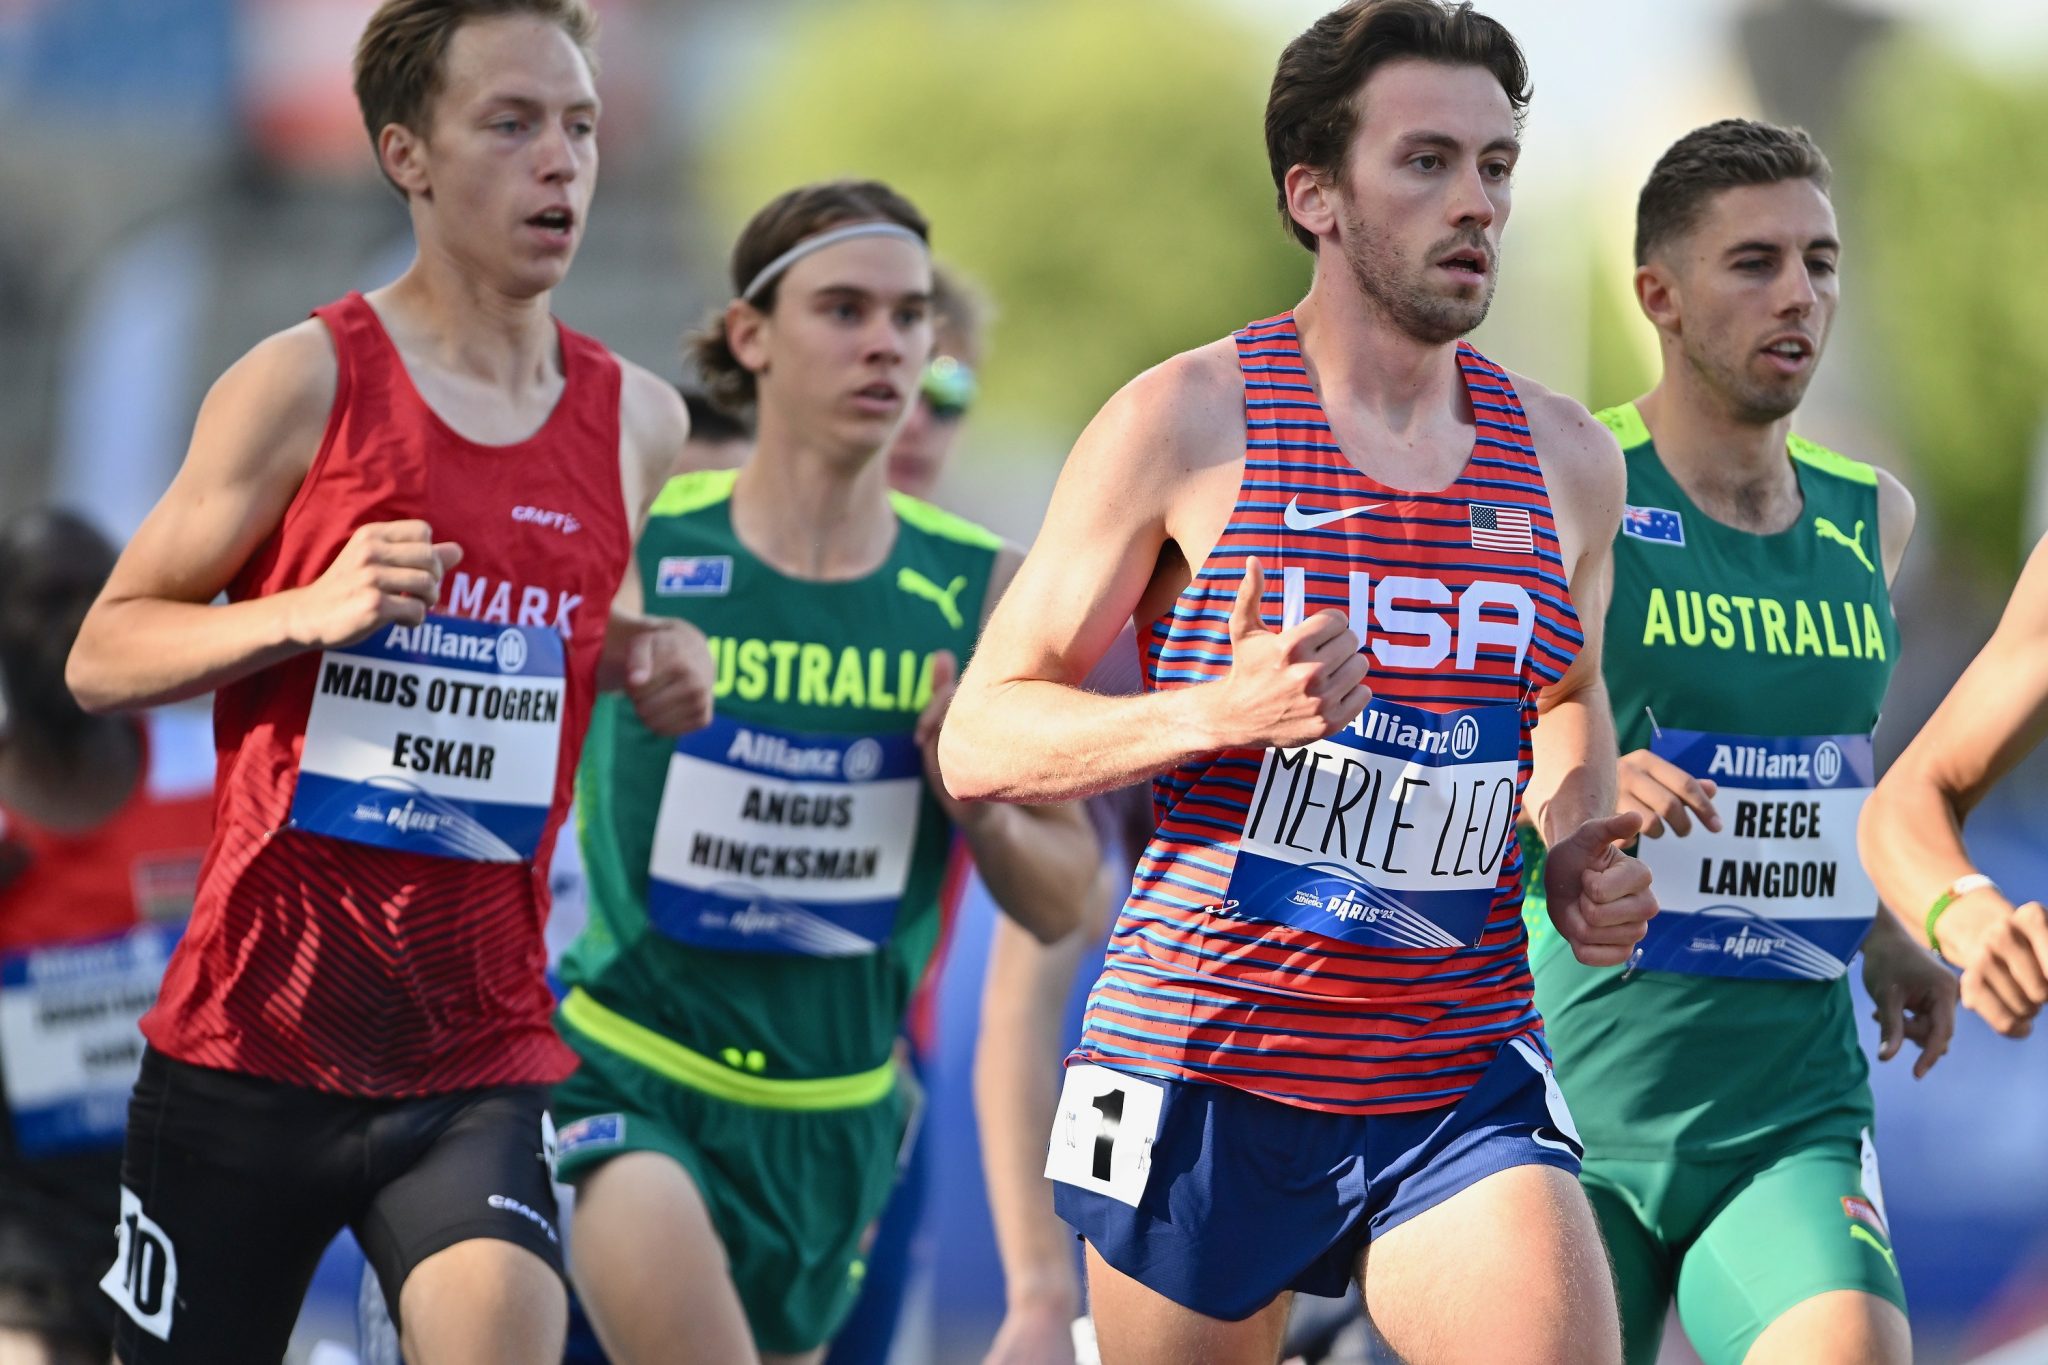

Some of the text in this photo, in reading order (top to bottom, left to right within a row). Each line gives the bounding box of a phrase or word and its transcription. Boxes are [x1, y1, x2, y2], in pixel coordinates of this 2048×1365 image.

[447, 571, 583, 640] MARK
[1282, 566, 1536, 675] USA
[1643, 587, 1886, 662] AUSTRALIA
[385, 622, 496, 663] Allianz
[321, 662, 558, 723] MADS OTTOGREN
[706, 636, 938, 712] USTRALIA
[727, 728, 840, 776] Allianz
[1342, 709, 1450, 755] Allianz
[392, 732, 496, 780] ESKAR
[1708, 744, 1810, 778] Allianz
[386, 798, 438, 834] PARIS
[741, 787, 852, 829] ANGUS
[1248, 747, 1514, 877] MERLE LEO
[1733, 800, 1821, 839] REECE
[689, 834, 879, 879] HINCKSMAN
[1699, 858, 1837, 898] LANGDON
[1326, 889, 1380, 923] PARIS
[1723, 925, 1772, 960] PARIS
[1092, 1088, 1125, 1183] 1
[123, 1214, 168, 1317] 10
